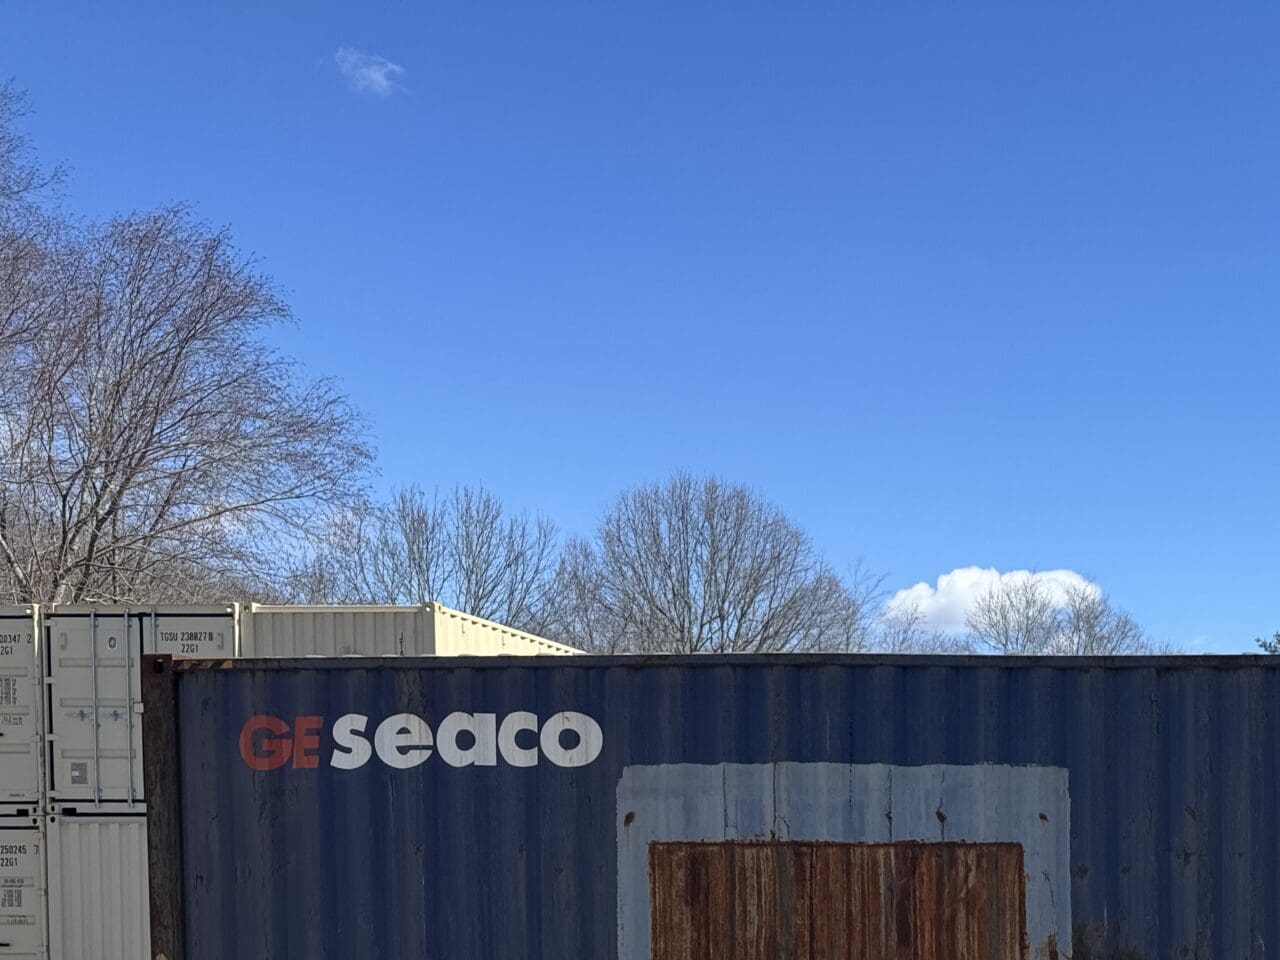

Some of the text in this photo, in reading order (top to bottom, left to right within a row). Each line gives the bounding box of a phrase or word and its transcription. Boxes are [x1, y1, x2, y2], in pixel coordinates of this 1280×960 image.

[27, 633, 32, 644] 2
[160, 631, 178, 642] TGSU
[181, 643, 199, 654] 22G1
[238, 711, 603, 771] GE seaco
[33, 844, 39, 855] 7
